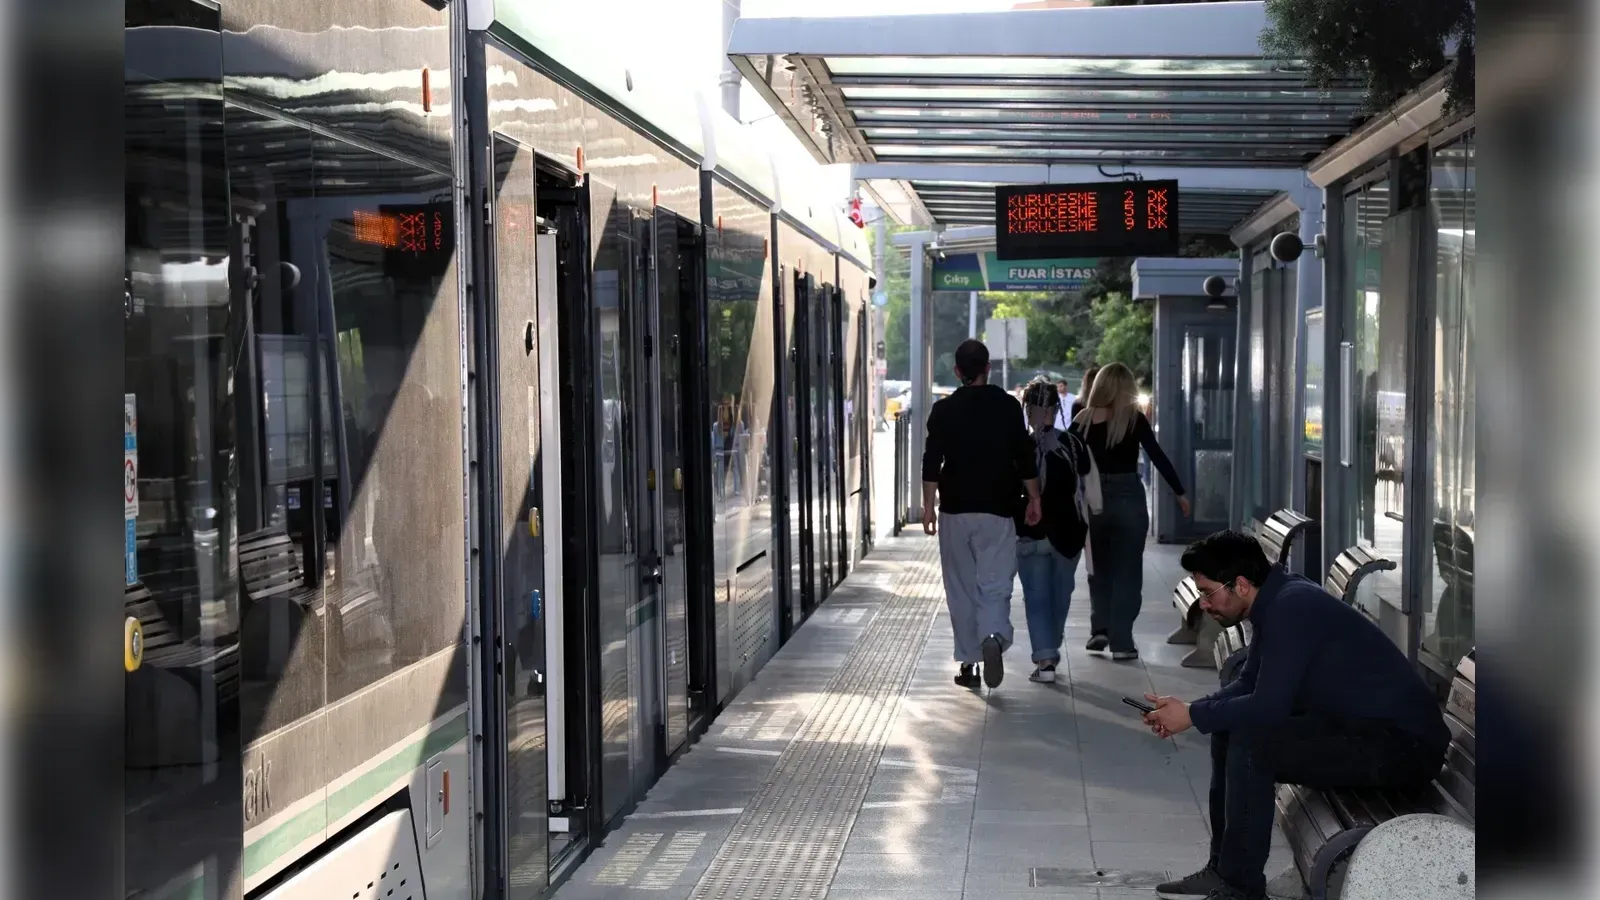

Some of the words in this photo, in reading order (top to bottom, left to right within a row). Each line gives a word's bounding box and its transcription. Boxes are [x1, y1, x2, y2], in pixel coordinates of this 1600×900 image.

[1008, 192, 1097, 207] KURUCESME
[1124, 190, 1134, 203] 2
[1147, 189, 1168, 202] DK
[1008, 206, 1097, 220] KURUCESME
[1124, 203, 1134, 217] 5
[1147, 203, 1168, 215] DK
[1008, 219, 1098, 233] KURUCESME
[1124, 217, 1134, 230] 9
[1147, 216, 1168, 229] DK
[943, 274, 970, 286] Çıkış
[1009, 268, 1047, 279] FUAR
